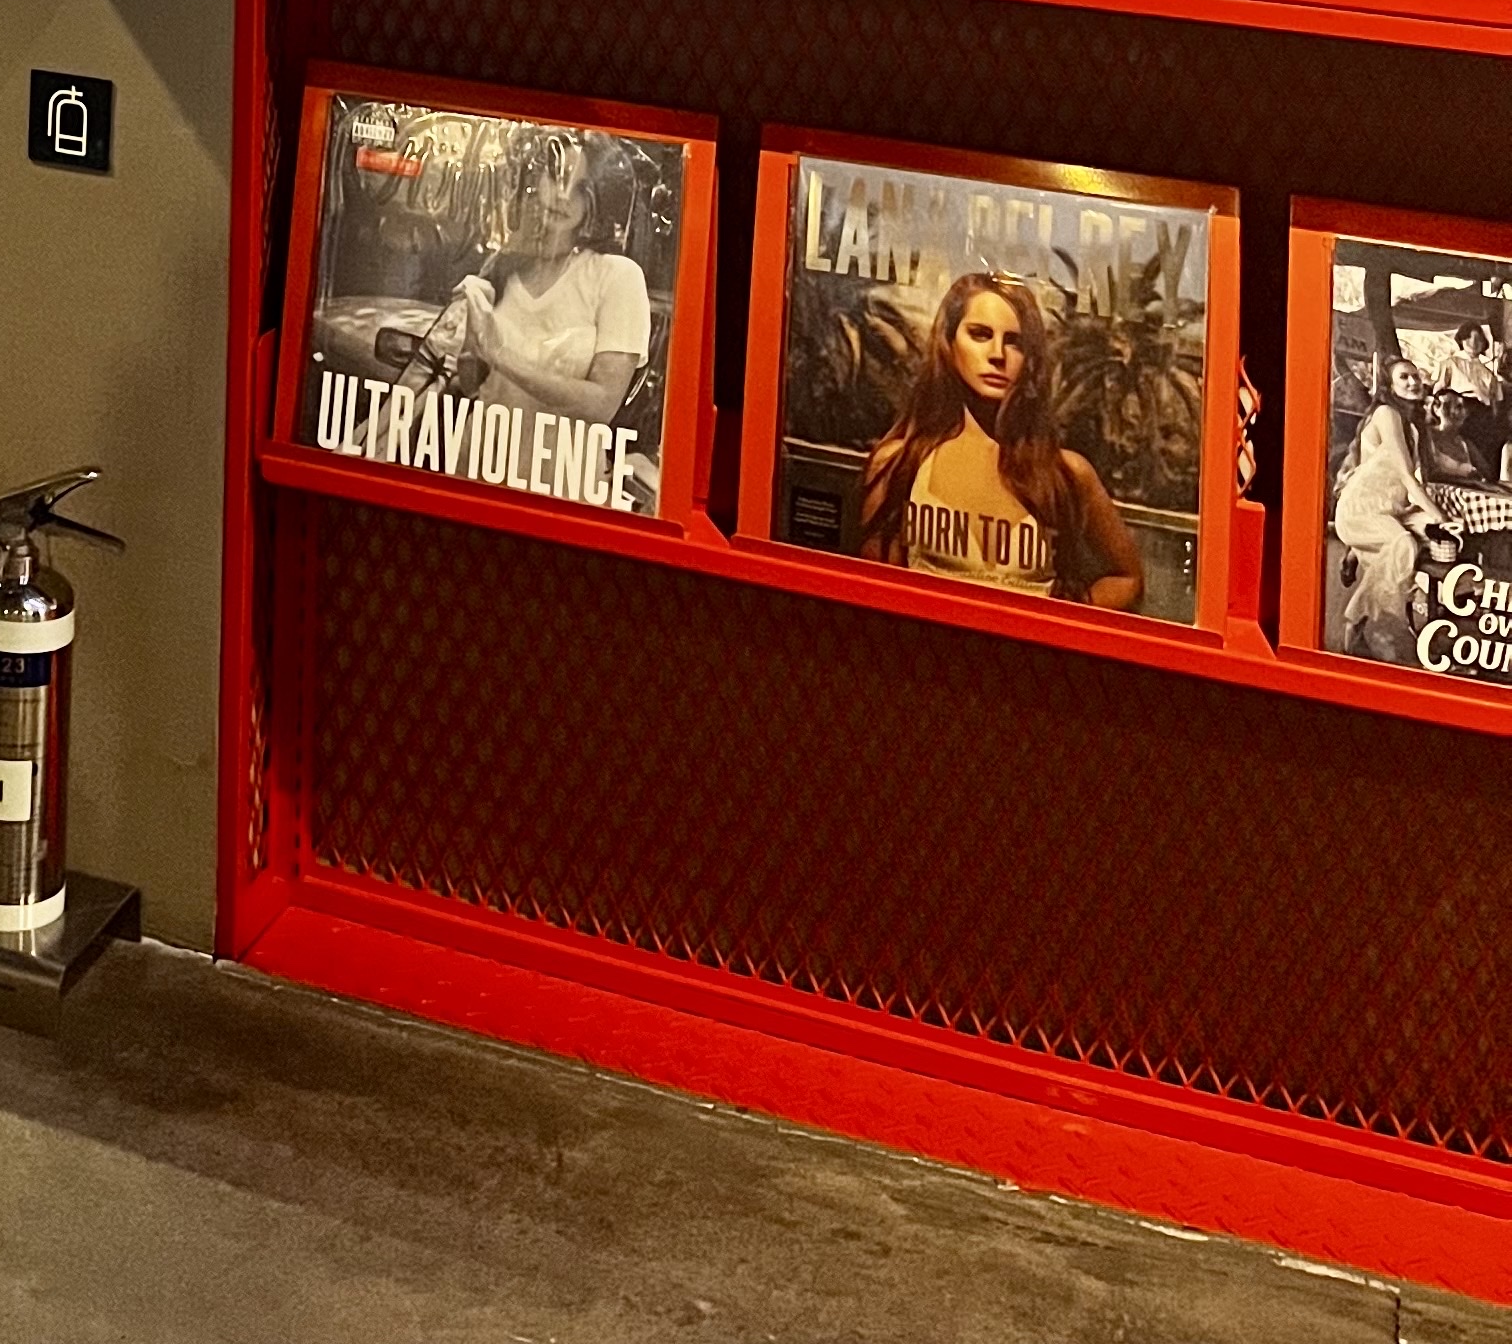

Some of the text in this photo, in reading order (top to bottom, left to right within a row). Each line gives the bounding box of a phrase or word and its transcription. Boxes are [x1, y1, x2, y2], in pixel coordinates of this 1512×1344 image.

[1076, 208, 1189, 324] REY
[316, 370, 639, 512] ULTRAVIOLENCE
[978, 514, 1011, 566] TO
